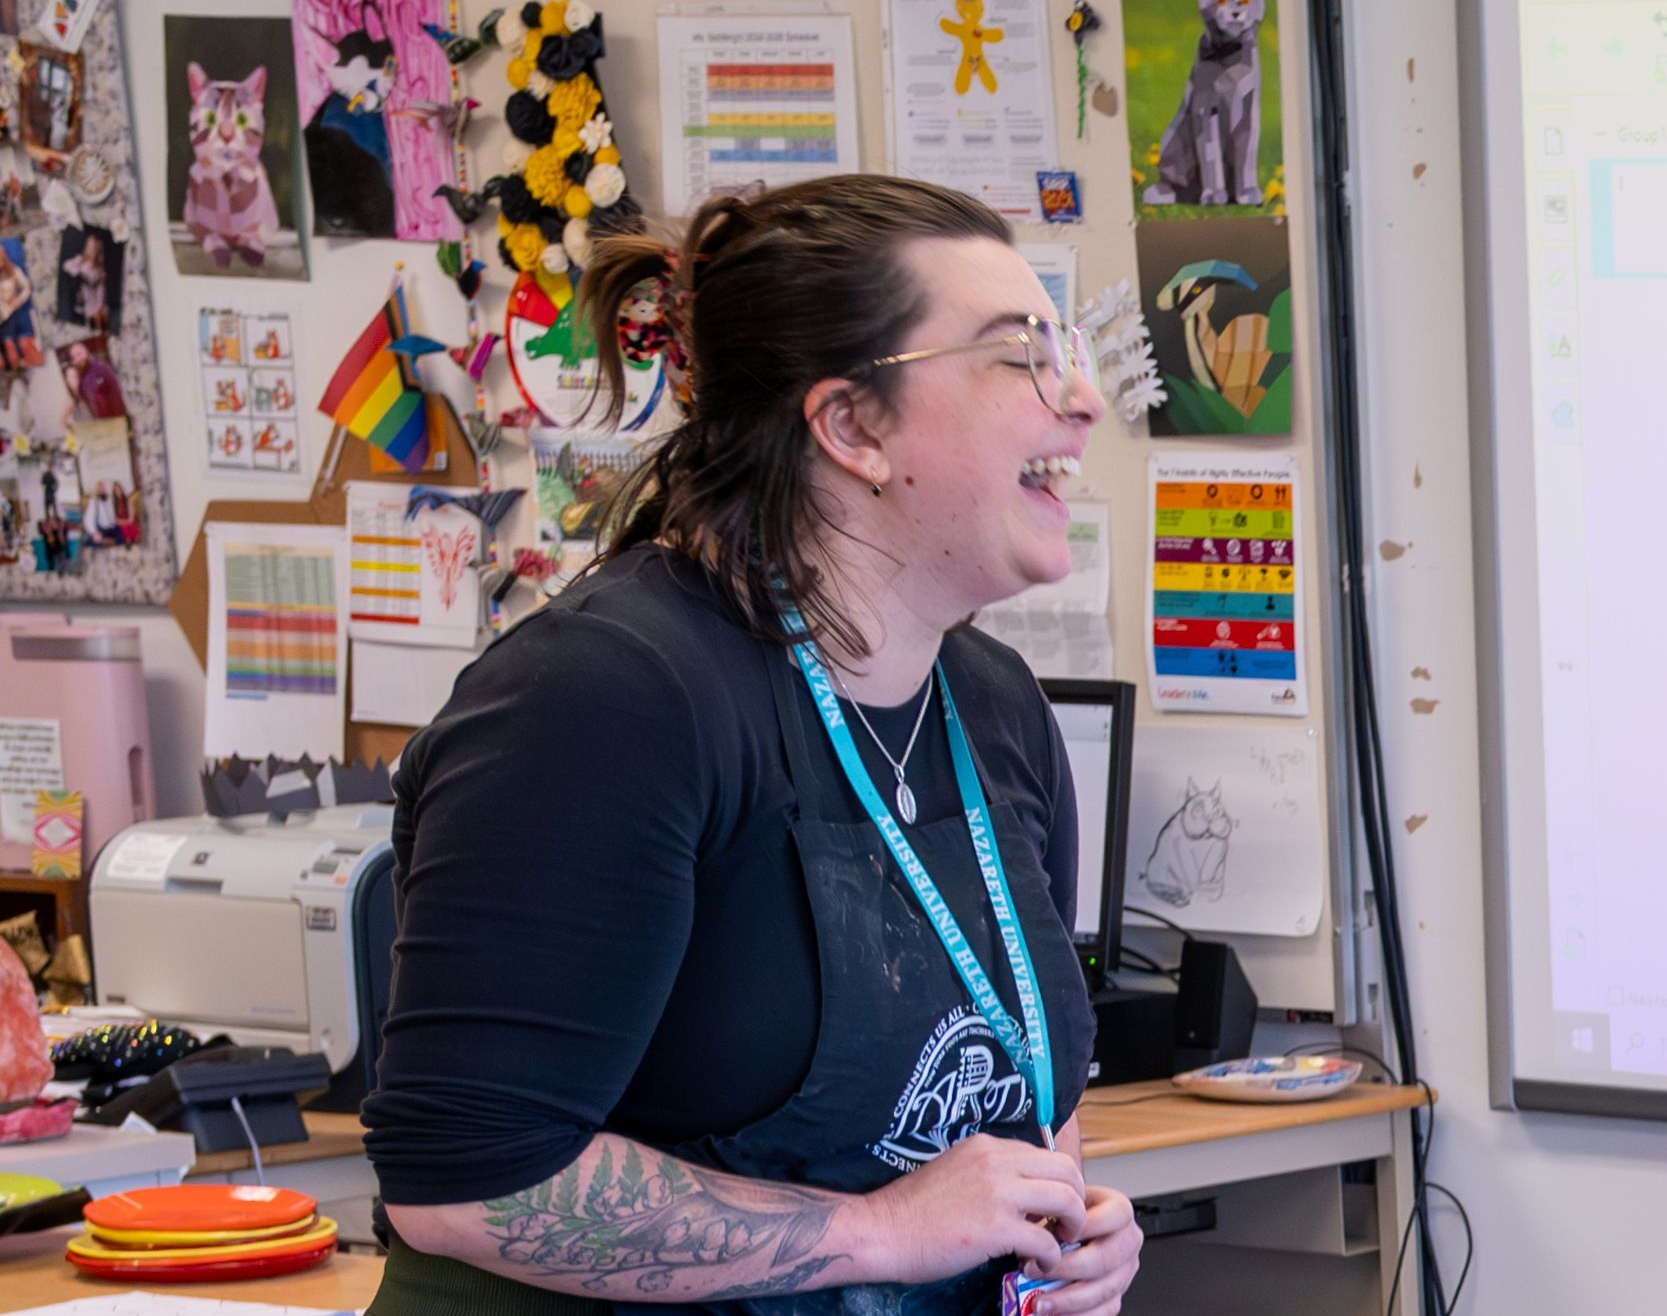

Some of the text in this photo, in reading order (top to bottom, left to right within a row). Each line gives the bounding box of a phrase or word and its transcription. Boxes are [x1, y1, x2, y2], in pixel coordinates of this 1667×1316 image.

[876, 814, 1025, 1065] NAZARETH UNIVERSITY
[965, 806, 1012, 922] NAZARETH
[1001, 925, 1047, 1059] UNIVERSITY
[893, 1034, 938, 1119] CONNECTS
[934, 1017, 948, 1039] US
[948, 1004, 966, 1027] ALL
